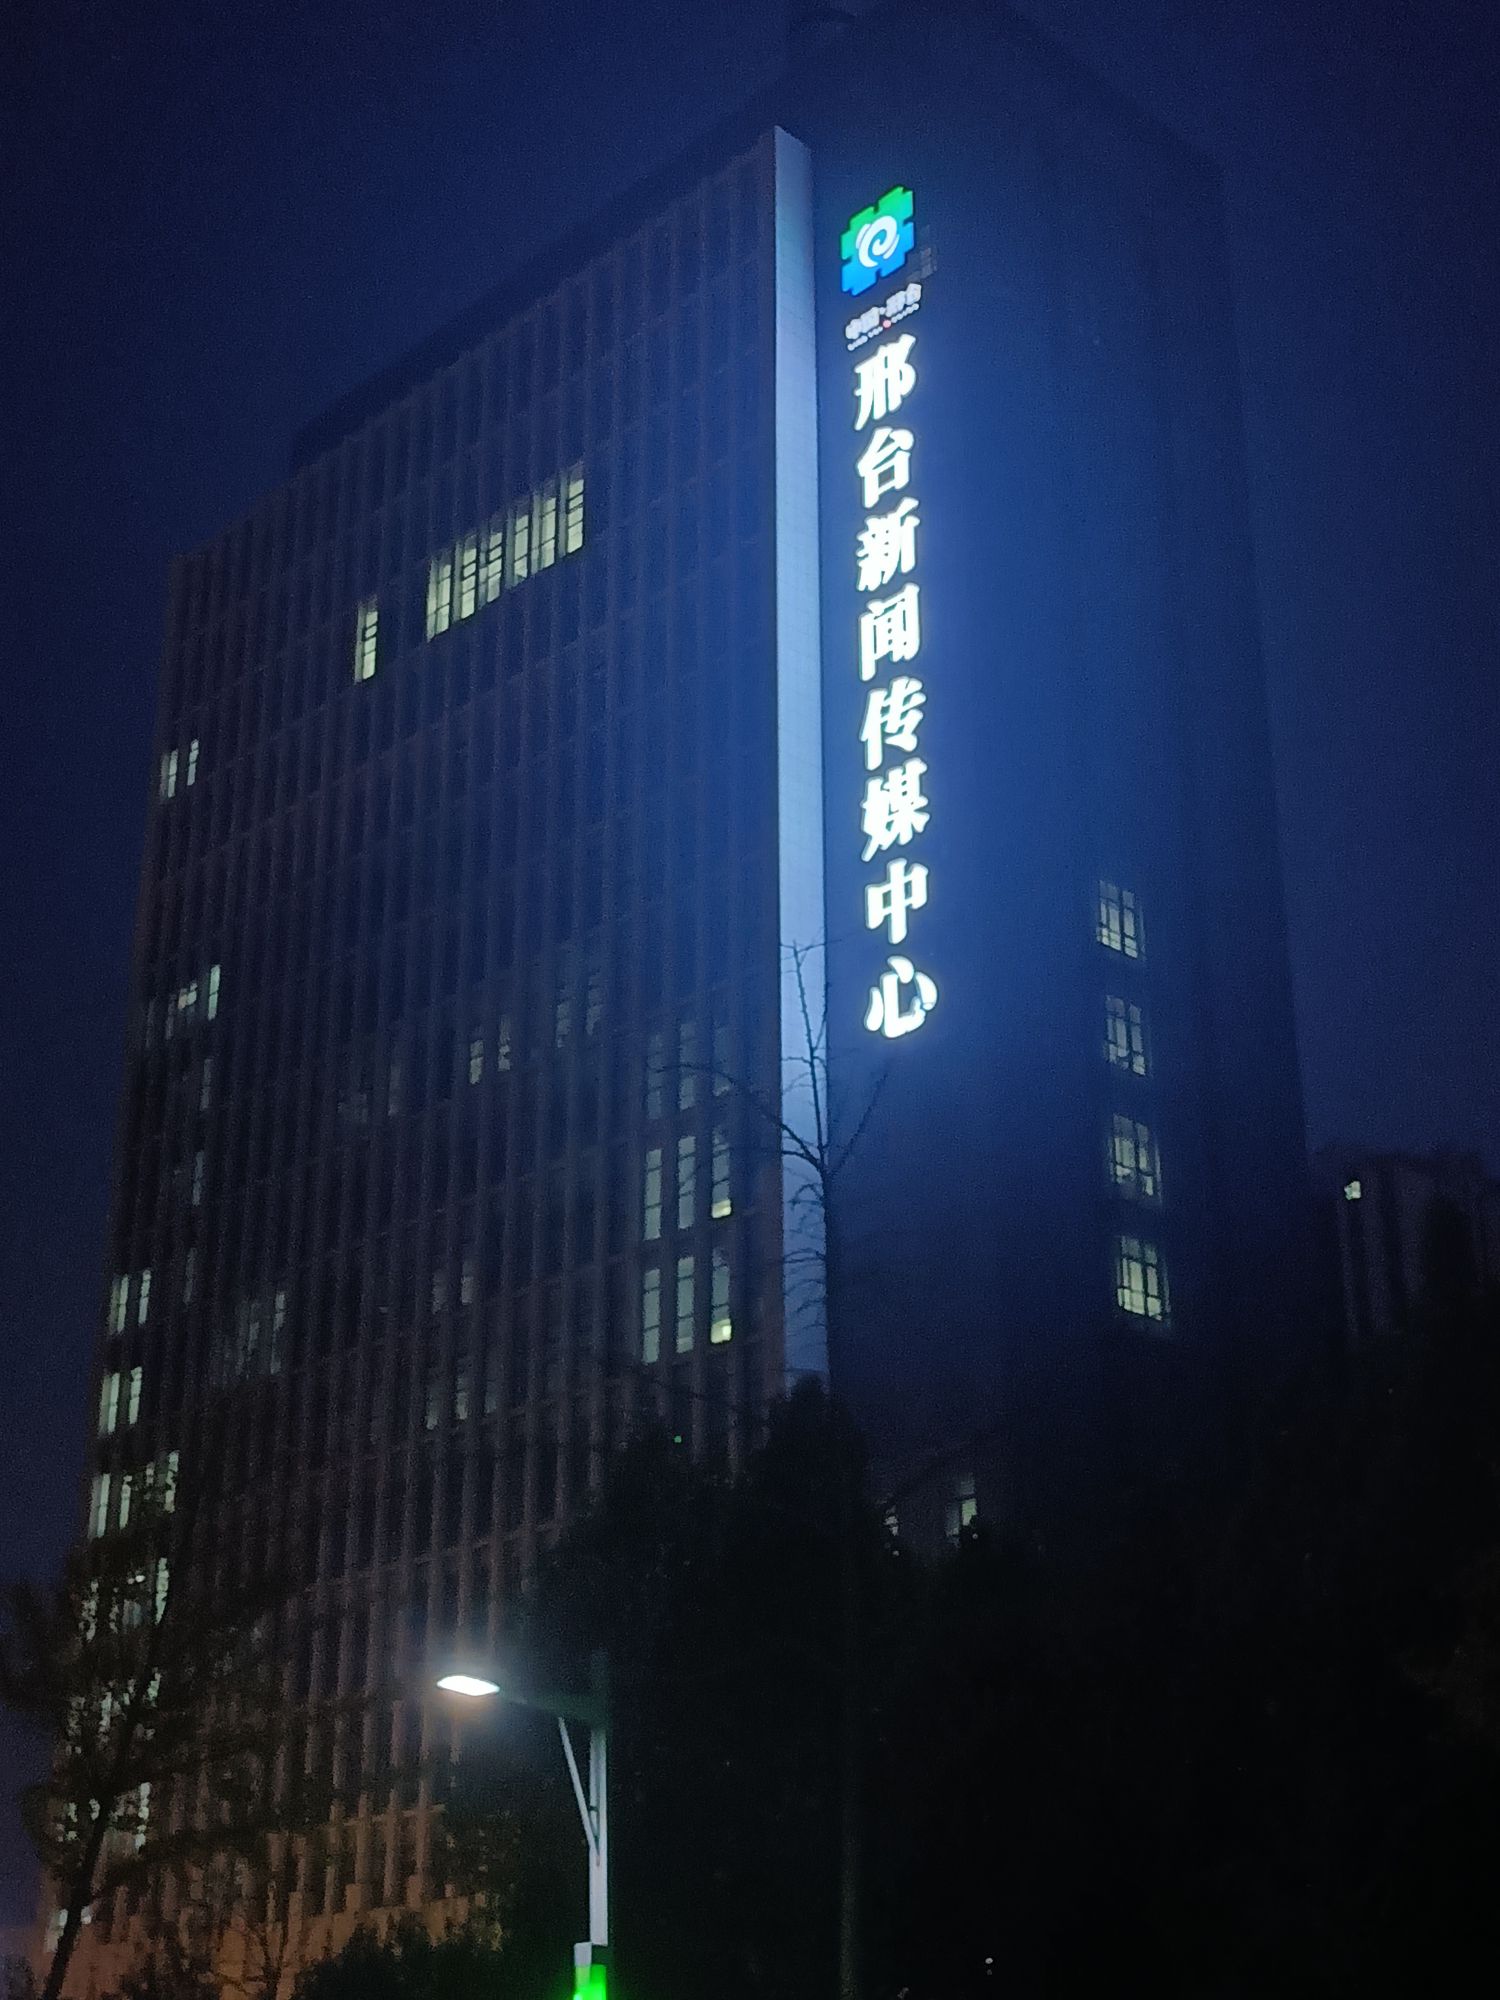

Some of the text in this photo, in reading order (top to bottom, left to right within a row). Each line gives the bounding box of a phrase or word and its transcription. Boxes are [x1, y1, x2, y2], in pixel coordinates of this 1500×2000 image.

[853, 333, 938, 1039] 邢台新闻传媒中心
